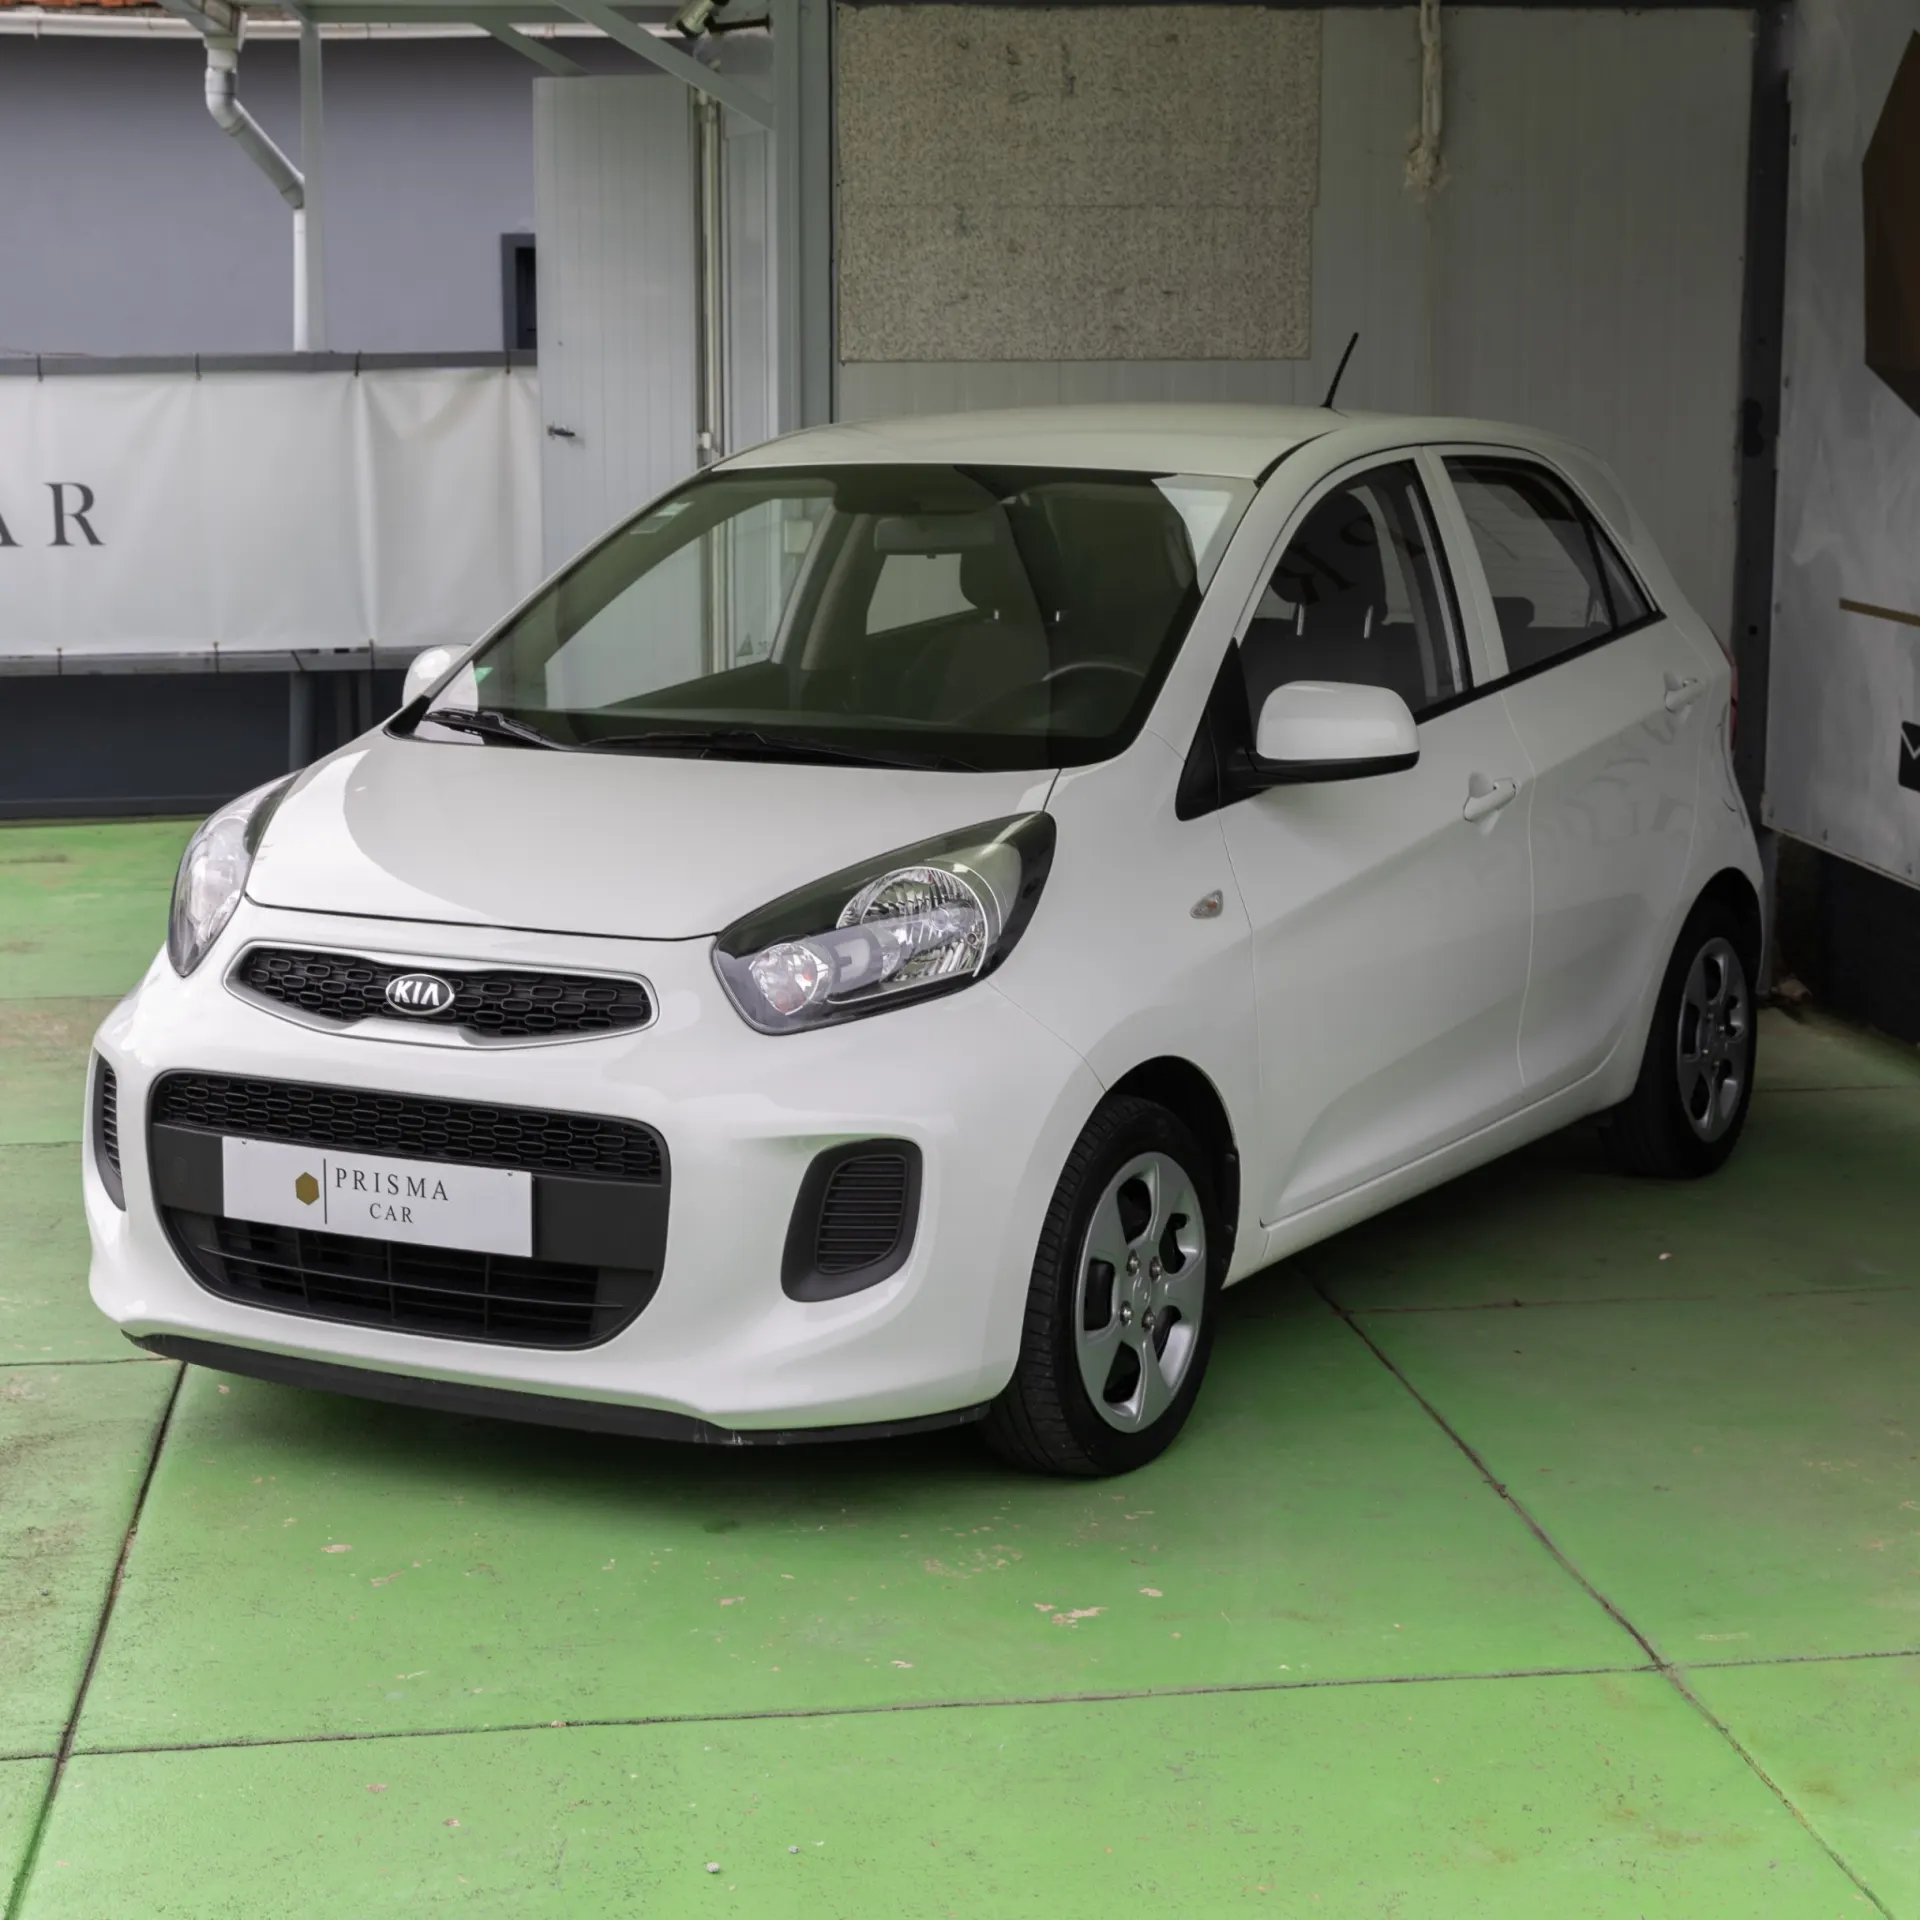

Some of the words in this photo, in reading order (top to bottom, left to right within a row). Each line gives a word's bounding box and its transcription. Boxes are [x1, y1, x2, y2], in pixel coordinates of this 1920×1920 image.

[394, 980, 440, 1006] KIA
[335, 1167, 448, 1201] PRISMA
[369, 1203, 414, 1224] CAR
